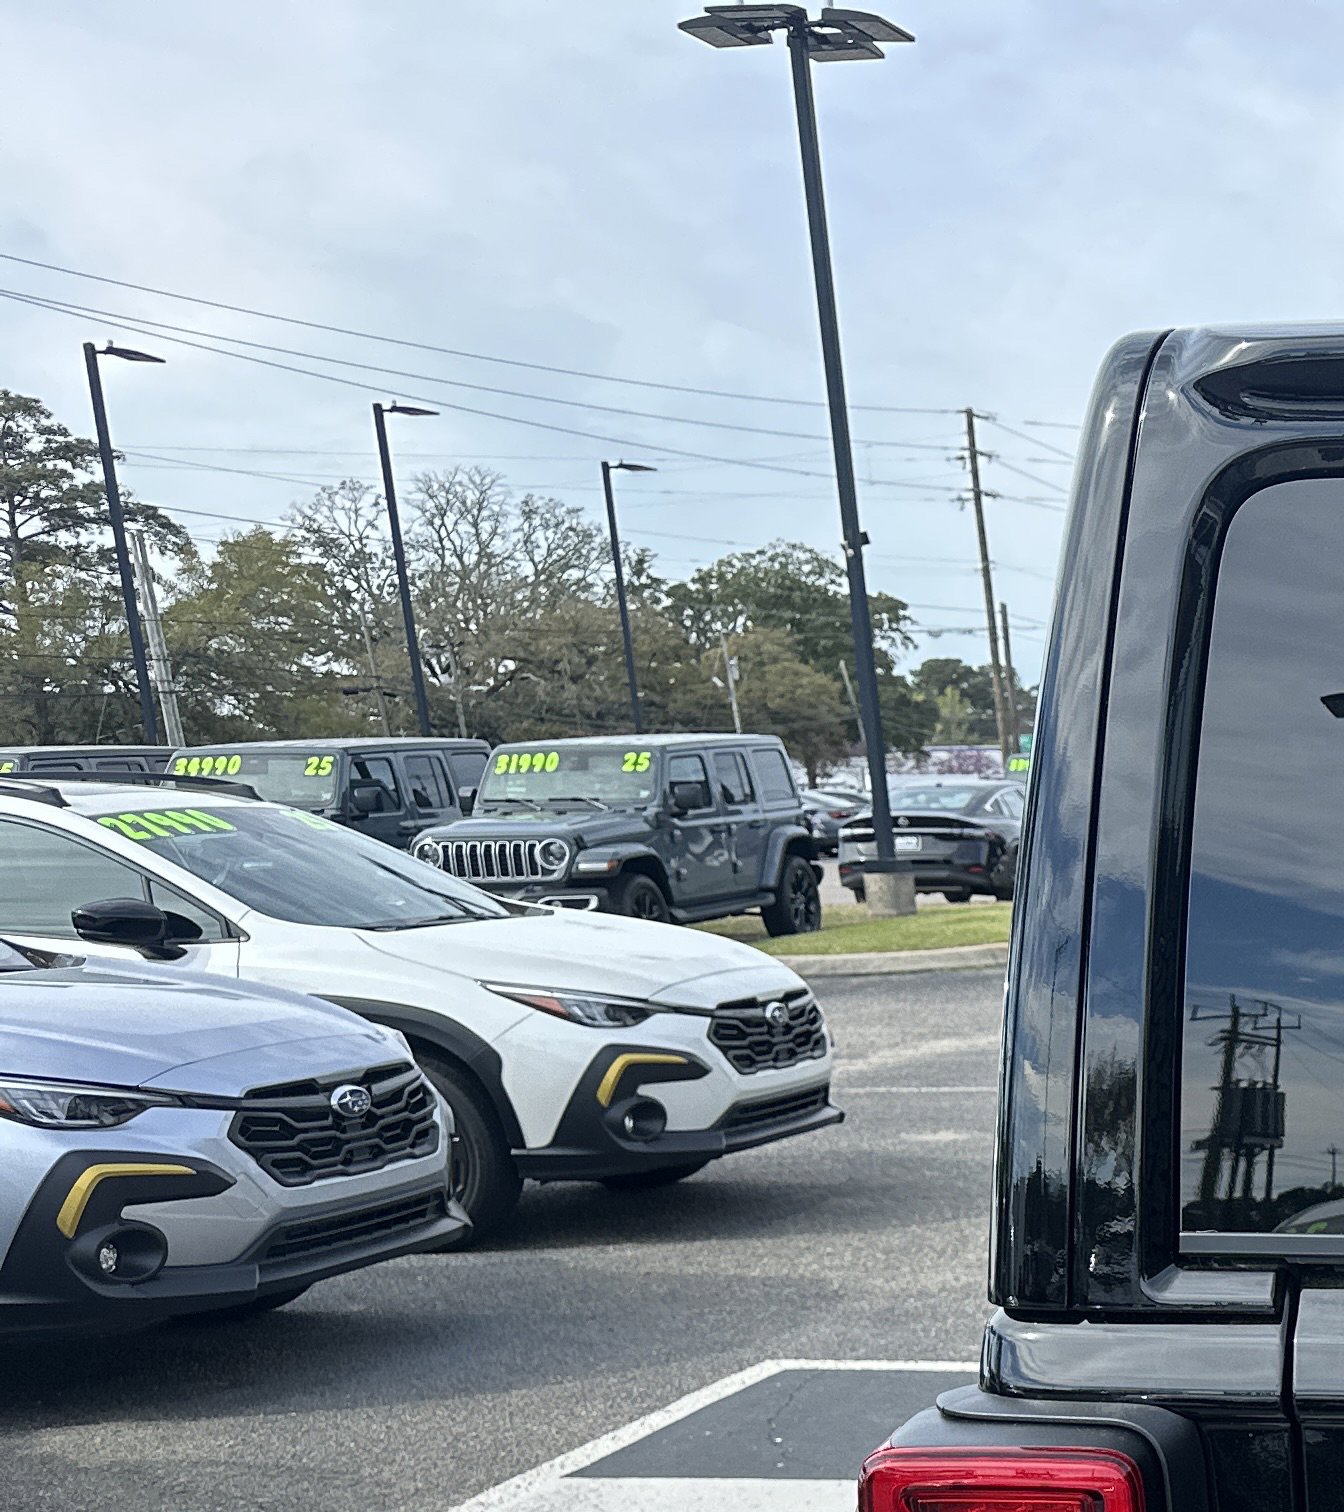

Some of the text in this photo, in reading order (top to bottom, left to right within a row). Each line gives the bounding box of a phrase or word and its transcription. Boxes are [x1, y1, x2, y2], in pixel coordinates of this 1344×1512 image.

[173, 755, 335, 776] 34990 25
[494, 751, 652, 775] 31990 25
